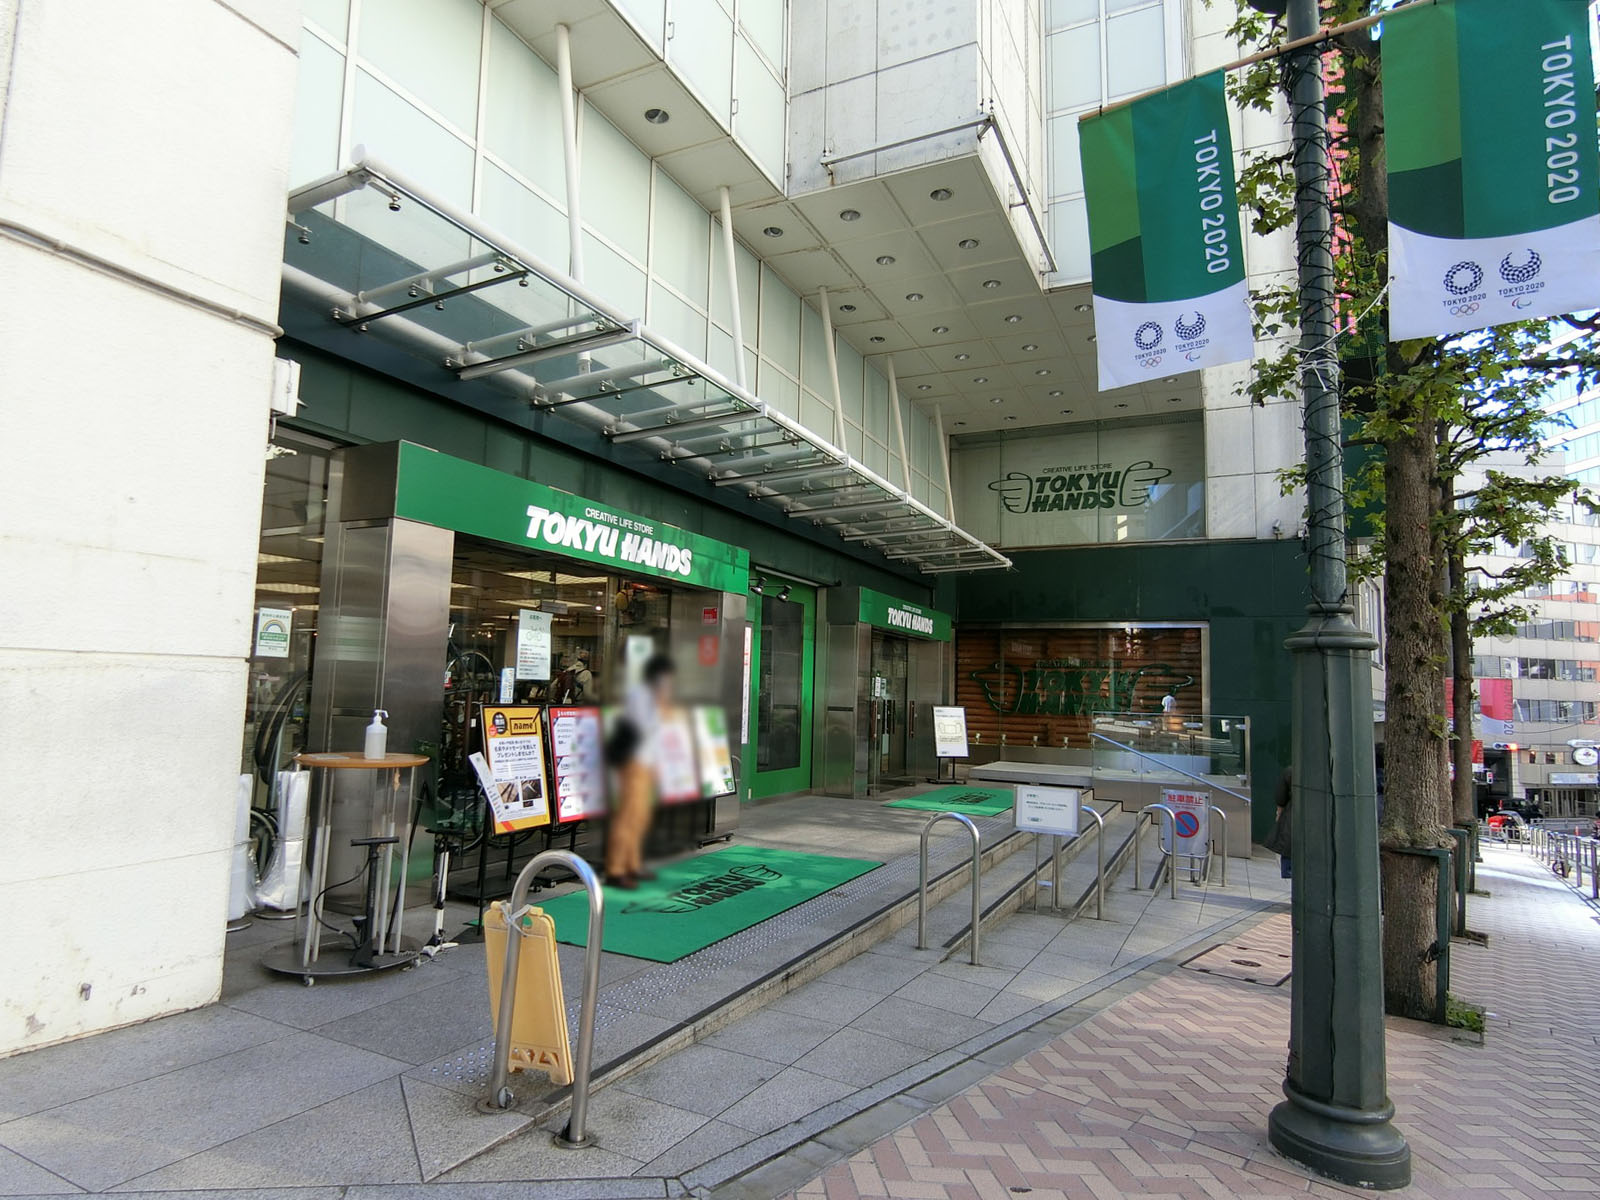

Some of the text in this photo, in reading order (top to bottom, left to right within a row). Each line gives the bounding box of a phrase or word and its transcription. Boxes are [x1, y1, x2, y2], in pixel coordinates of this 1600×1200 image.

[1541, 34, 1580, 205] TOKYO 2020
[1193, 129, 1230, 274] TOKYO 2020
[1442, 292, 1486, 307] TOKYO 2020
[1498, 286, 1524, 295] TOKYO
[1525, 281, 1545, 290] 2020
[1134, 351, 1151, 360] TOKYO
[1152, 347, 1167, 356] 2020
[1174, 341, 1194, 350] TOKYO
[1195, 338, 1210, 347] 2020
[1042, 463, 1113, 474] CREATIVE LIFE STORE
[1035, 471, 1121, 494] TOKYU
[1032, 489, 1116, 512] HANDS
[585, 507, 654, 536] CREATIVE LIFE STORE
[526, 505, 692, 576] TOKYU HANDS
[887, 607, 912, 629] TOKYU
[912, 614, 934, 635] HANDS
